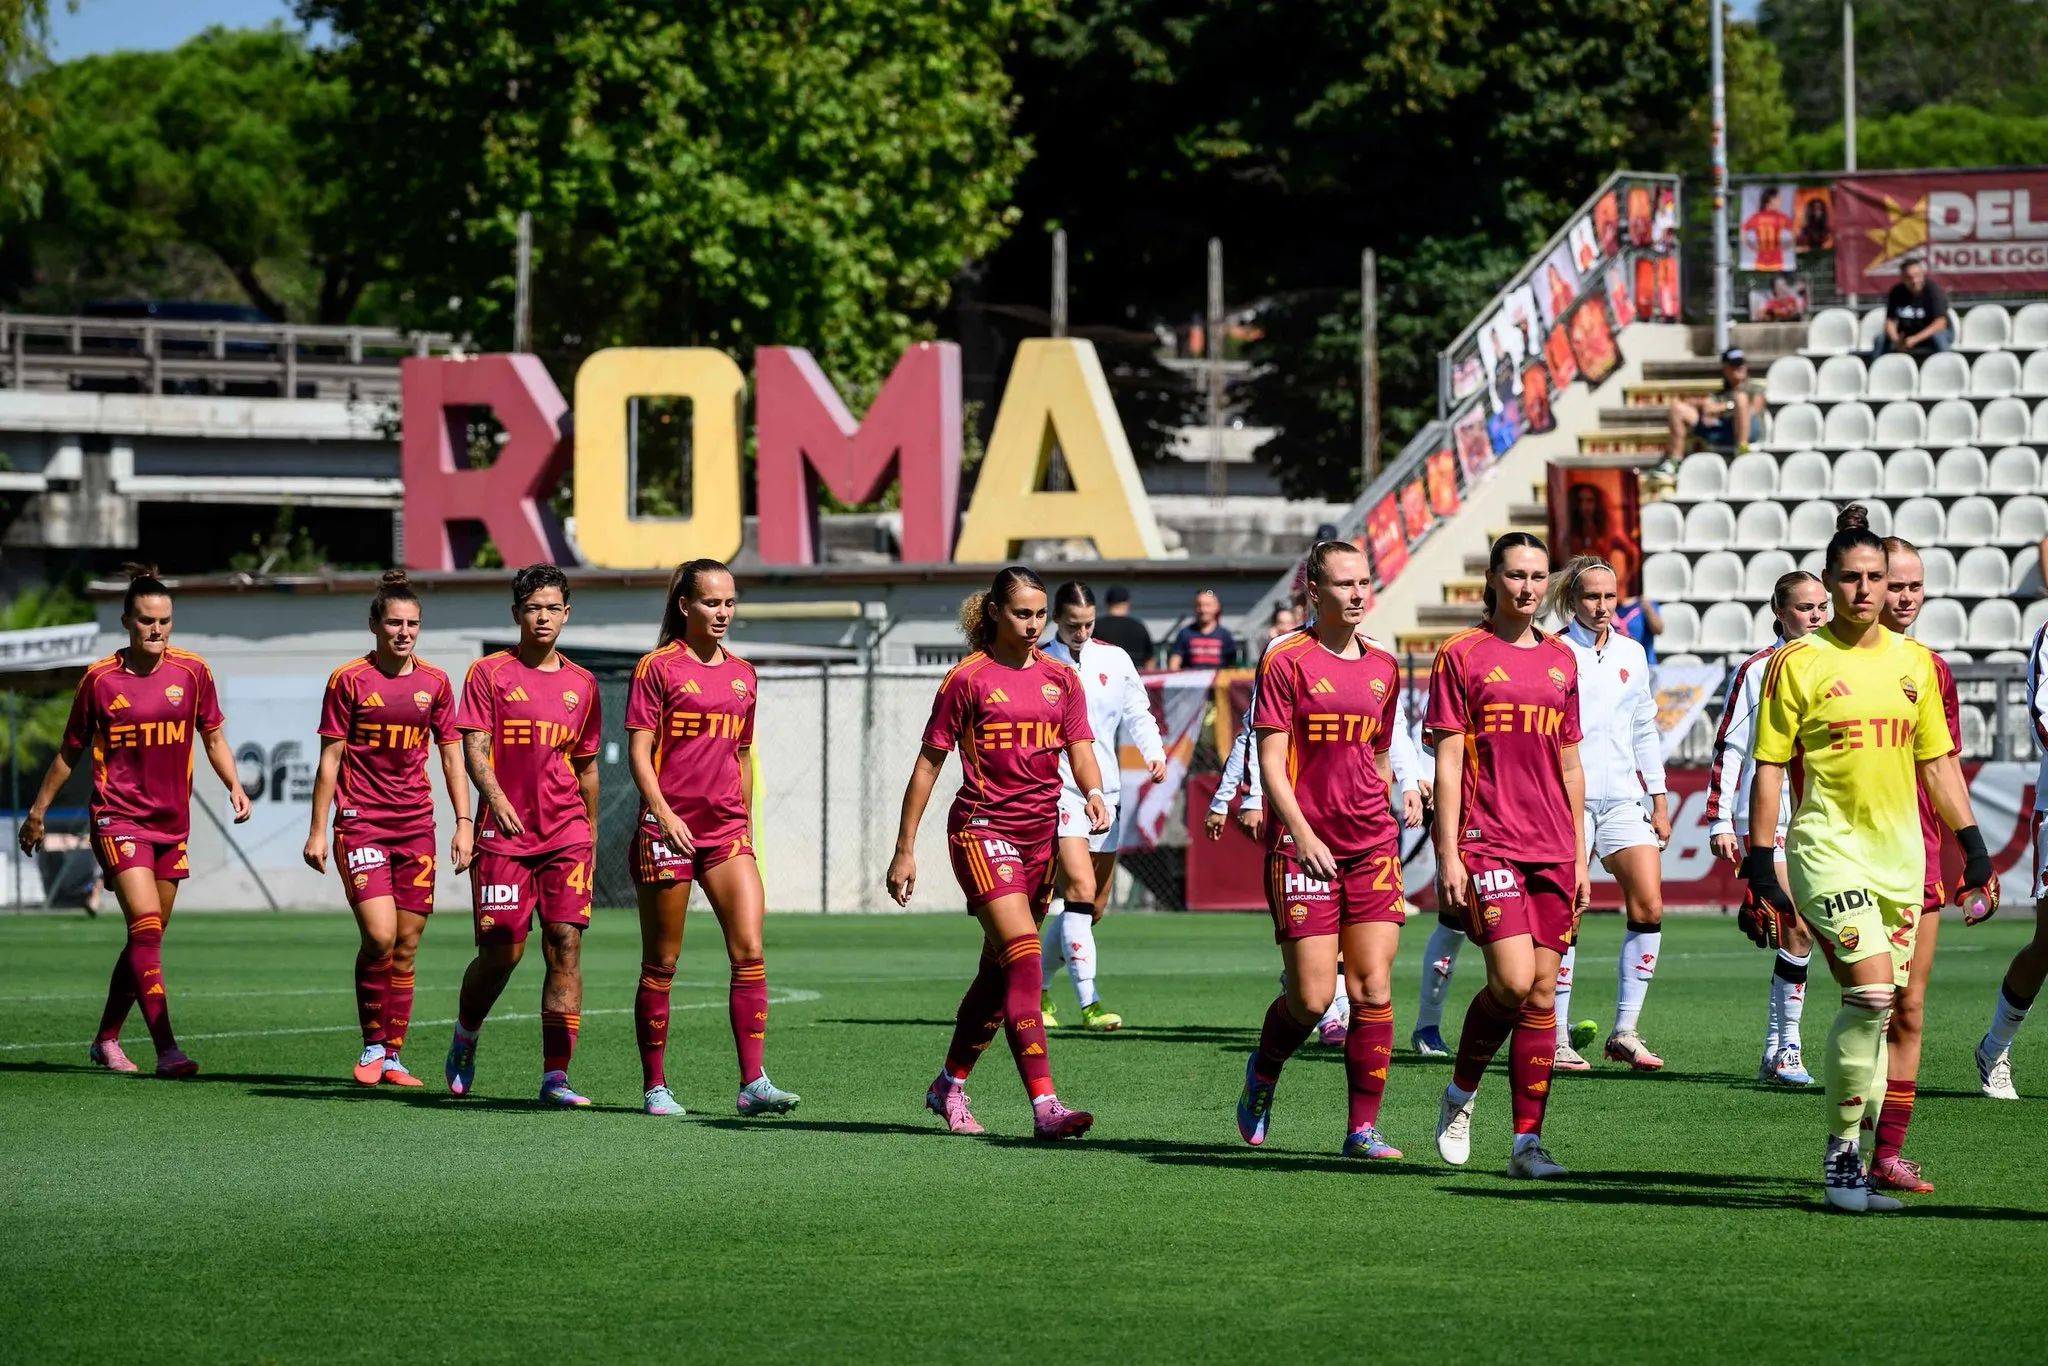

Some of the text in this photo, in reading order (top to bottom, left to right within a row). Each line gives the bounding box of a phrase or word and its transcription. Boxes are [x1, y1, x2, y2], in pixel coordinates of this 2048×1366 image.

[1934, 248, 2048, 267] NOLEGG
[401, 337, 1165, 573] ROMA
[140, 720, 186, 746] TIM
[706, 712, 747, 740] TIM
[1519, 704, 1565, 736] TIM
[1869, 718, 1918, 748] TIM
[386, 724, 428, 749] TIM
[1016, 721, 1061, 748] TIM
[413, 854, 436, 888] 2
[1285, 873, 1331, 893] HDI
[481, 884, 519, 904] HDI
[1016, 1018, 1037, 1032] ASR
[1530, 1056, 1553, 1066] ASR
